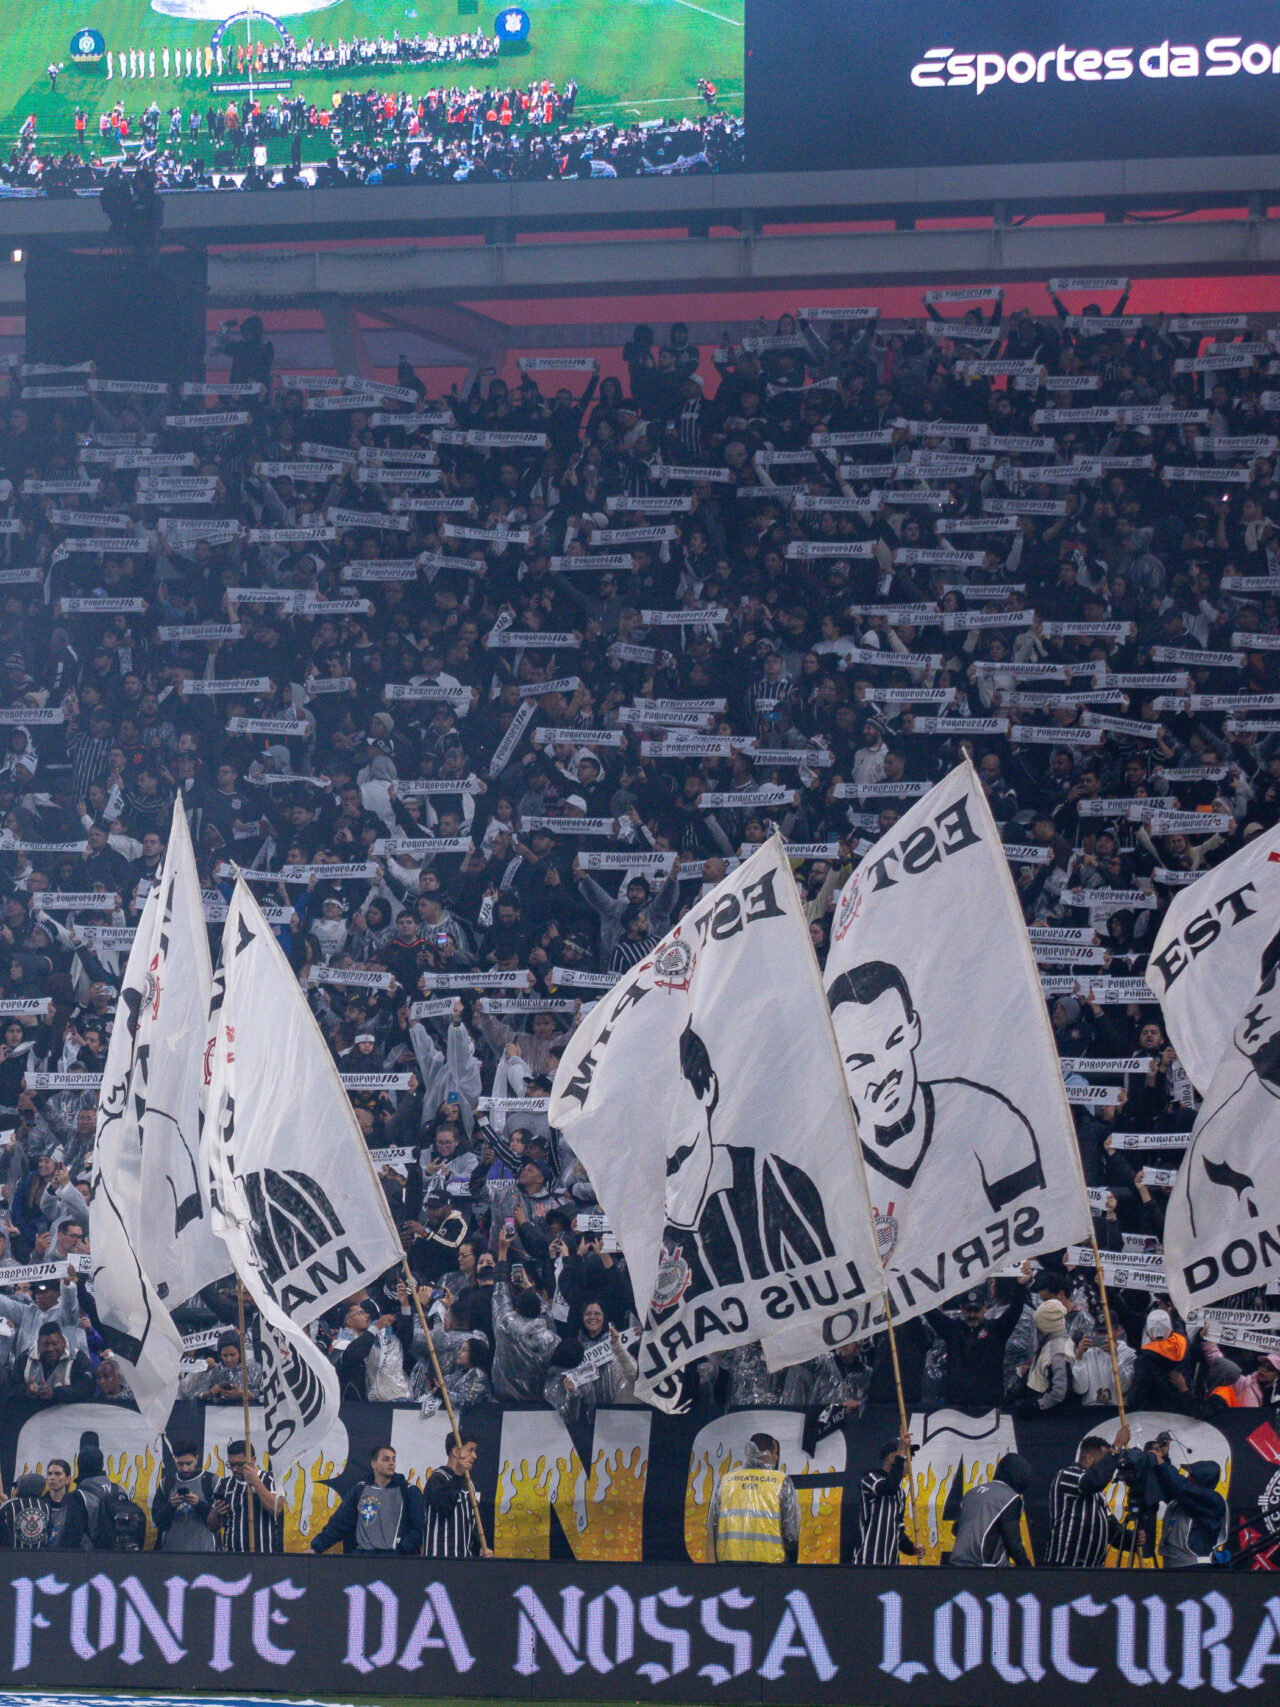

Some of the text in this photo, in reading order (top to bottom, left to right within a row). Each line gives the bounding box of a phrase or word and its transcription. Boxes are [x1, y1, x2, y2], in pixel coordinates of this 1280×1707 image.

[910, 43, 1133, 95] Esportes
[1139, 40, 1200, 78] da
[1151, 881, 1258, 996] EST
[11, 1573, 307, 1673] FONTE
[343, 1580, 476, 1675] DA
[512, 1584, 840, 1686] NOSSA
